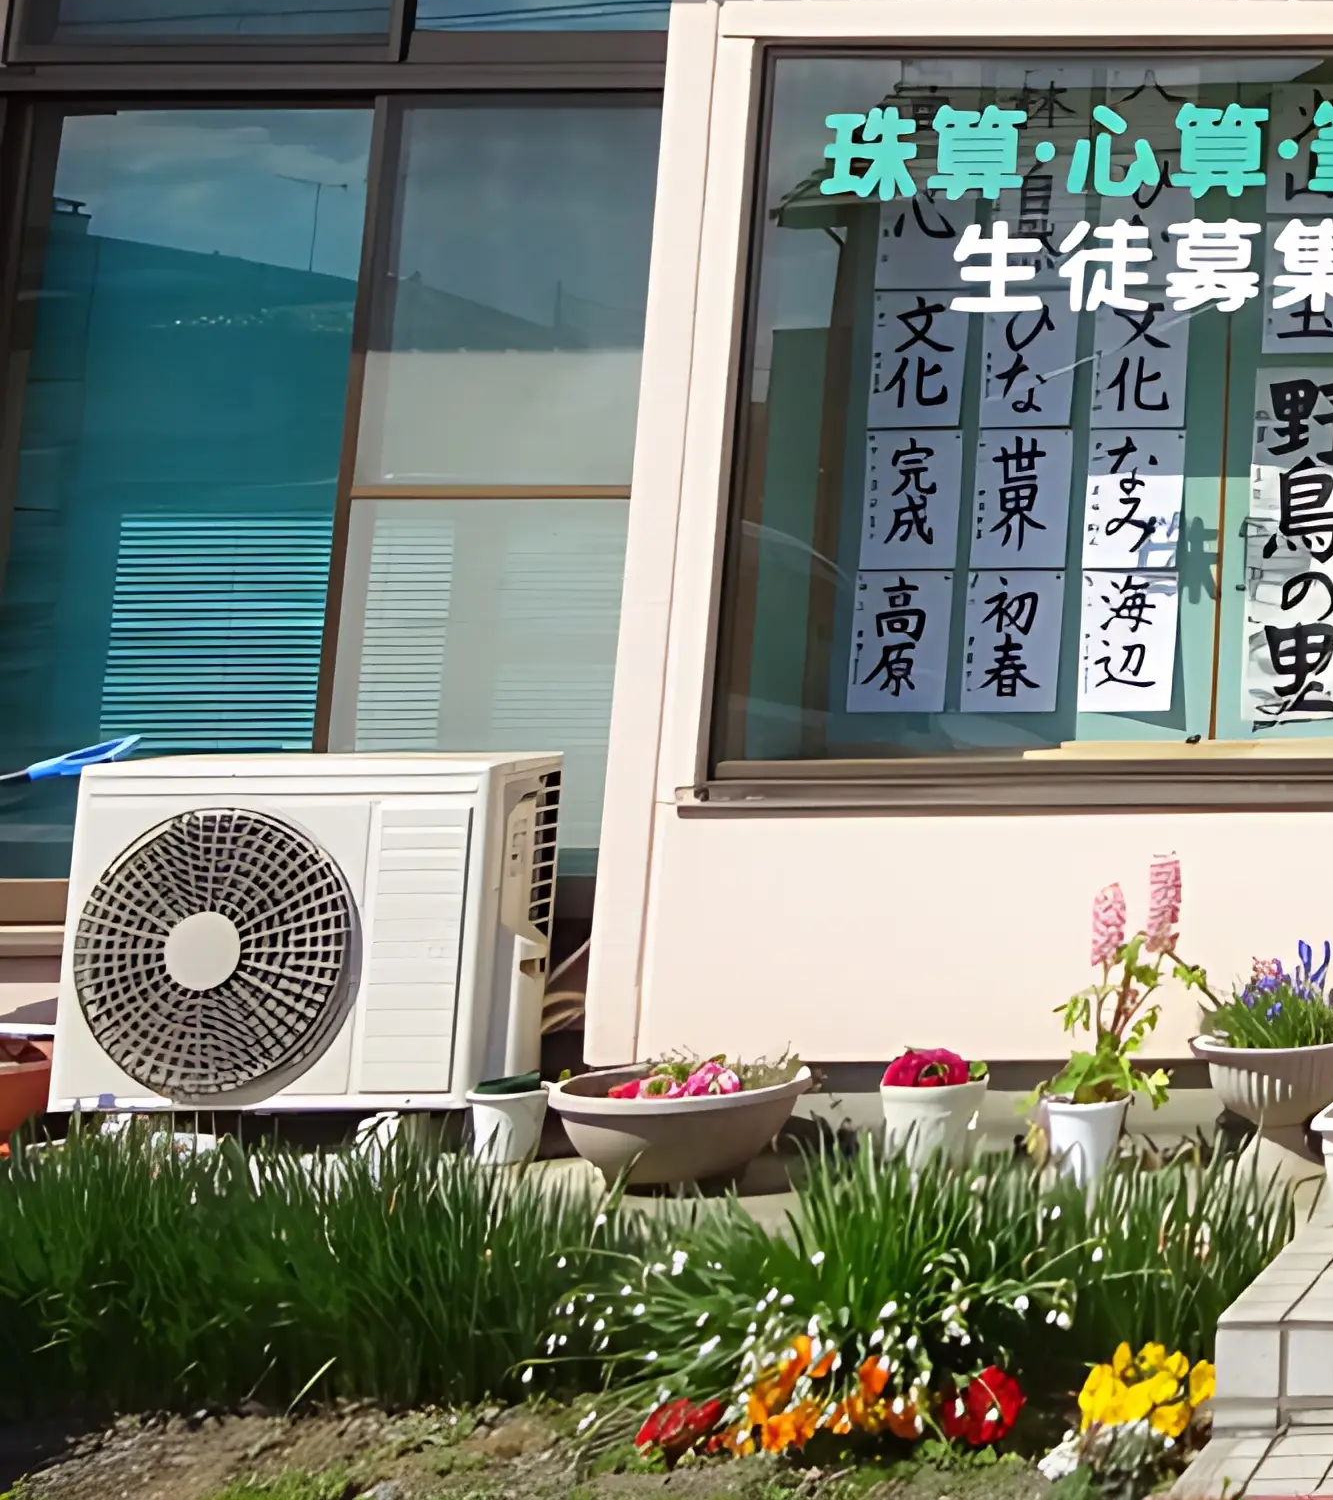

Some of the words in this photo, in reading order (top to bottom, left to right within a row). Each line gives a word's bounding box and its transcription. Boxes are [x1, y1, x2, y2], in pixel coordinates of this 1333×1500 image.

[885, 297, 955, 408] 文化
[884, 437, 937, 545] 完成
[989, 436, 1047, 551] 世界
[861, 577, 928, 697] 高原
[981, 577, 1041, 697] 初春
[1094, 575, 1157, 689] 海辺
